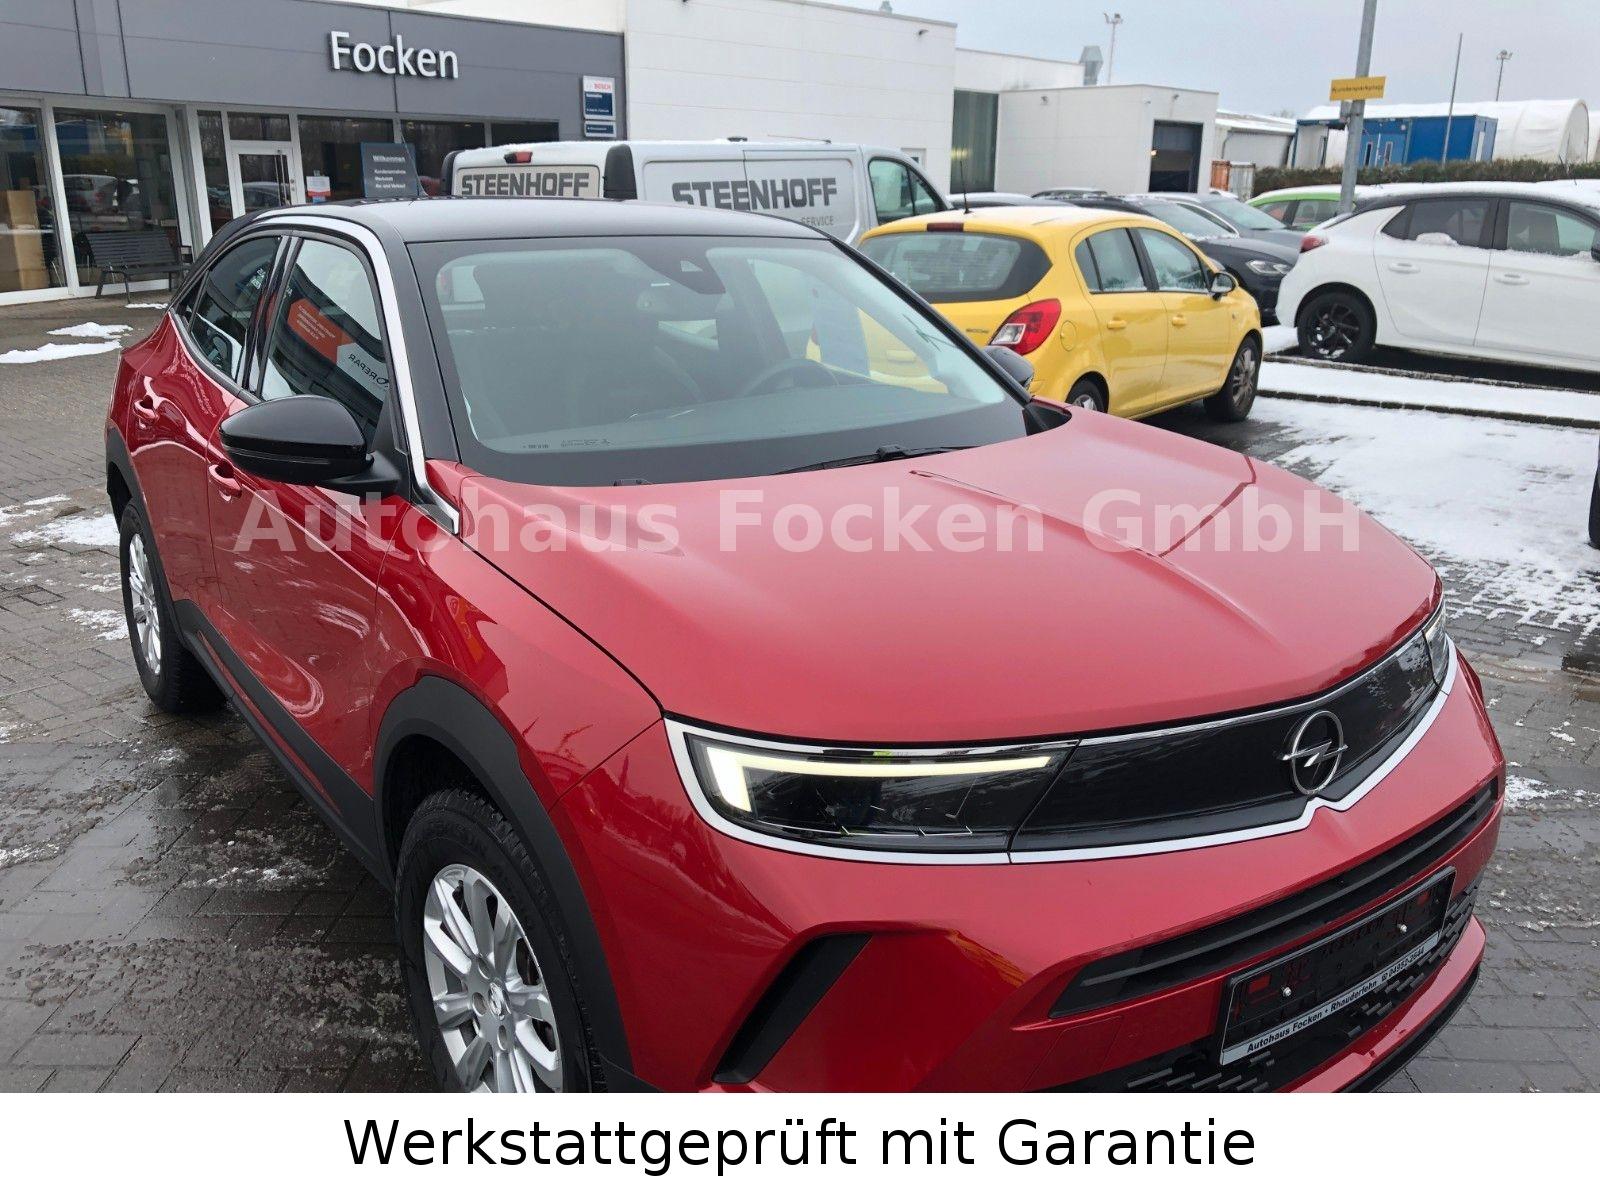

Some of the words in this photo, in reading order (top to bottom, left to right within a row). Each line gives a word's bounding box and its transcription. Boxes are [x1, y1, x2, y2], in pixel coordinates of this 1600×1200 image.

[330, 30, 459, 79] Focken
[462, 173, 589, 197] STEENHOFF
[672, 178, 838, 211] STEENHOFF
[1246, 1029, 1291, 1054] Autohaus
[1292, 1011, 1322, 1032] Focken
